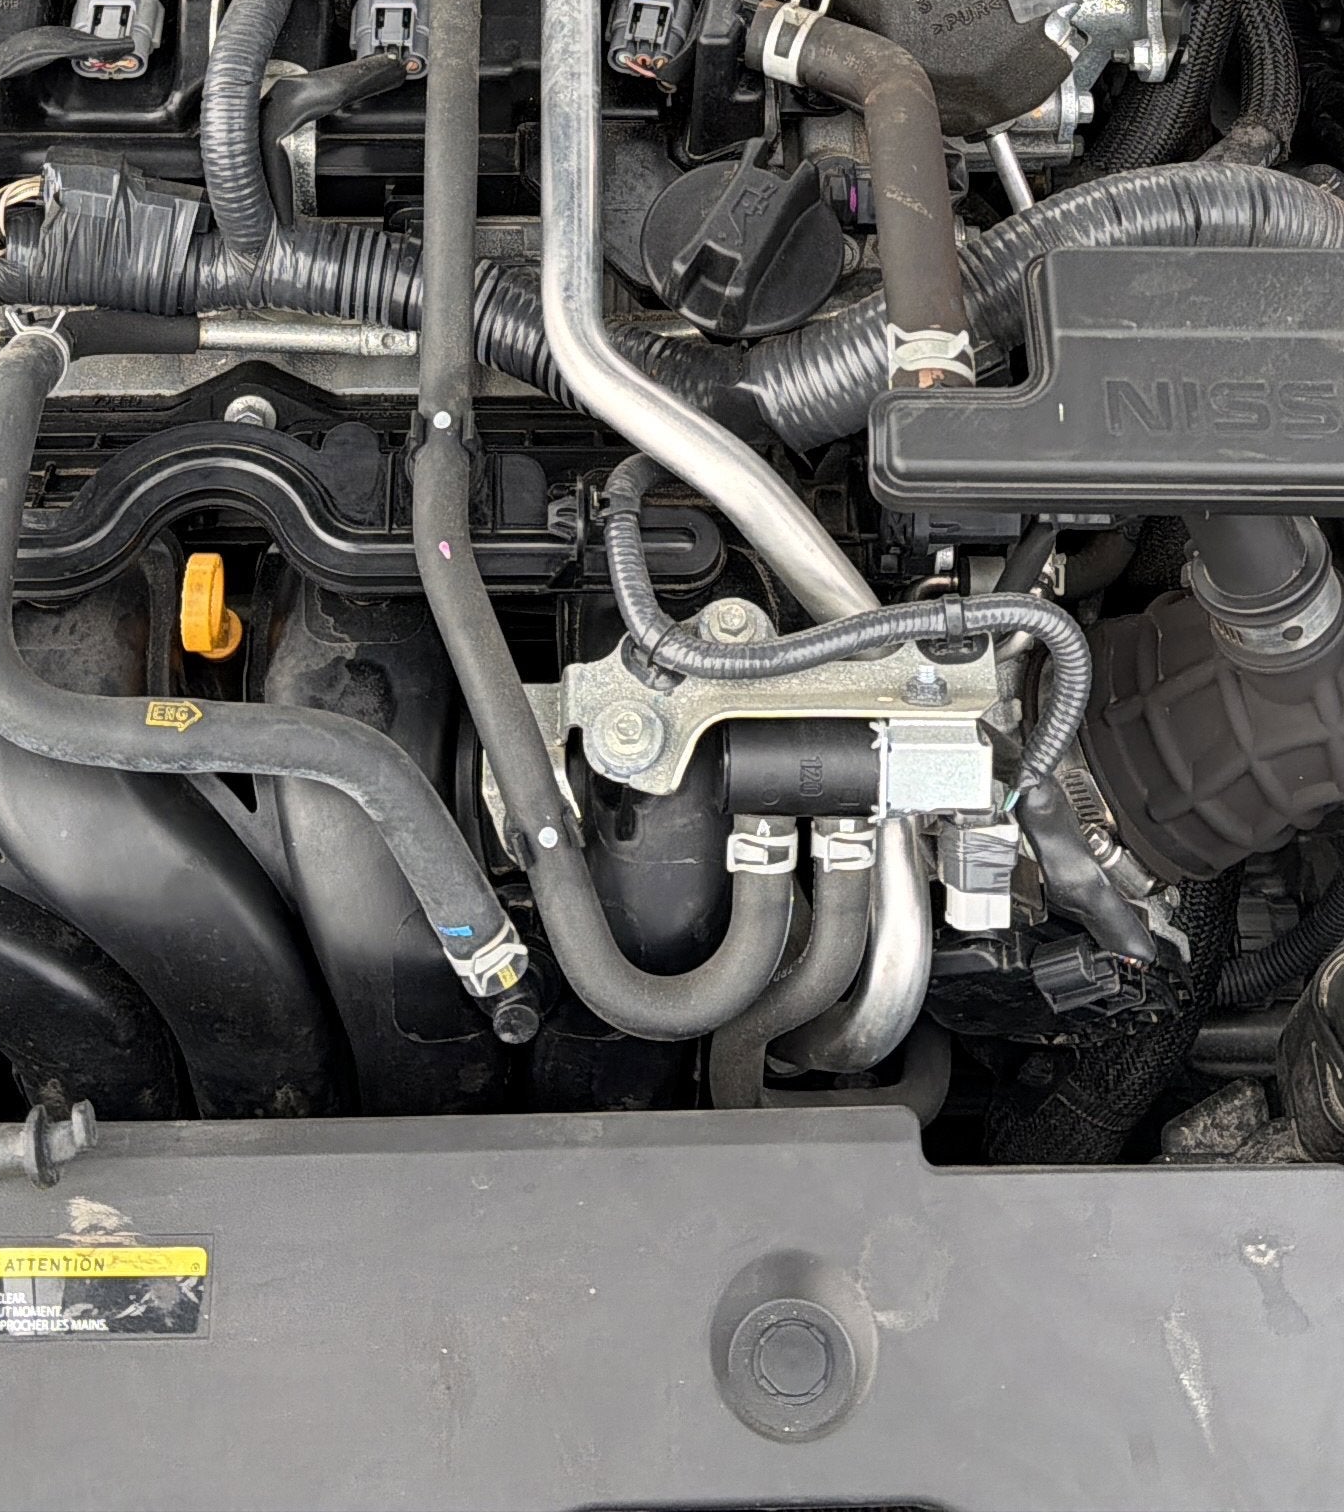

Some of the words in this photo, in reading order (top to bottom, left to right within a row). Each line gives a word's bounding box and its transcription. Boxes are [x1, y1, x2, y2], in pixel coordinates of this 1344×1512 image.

[152, 705, 189, 721] ENG
[799, 755, 825, 797] 120
[5, 1257, 105, 1272] ATTENTION
[50, 1319, 70, 1331] LES
